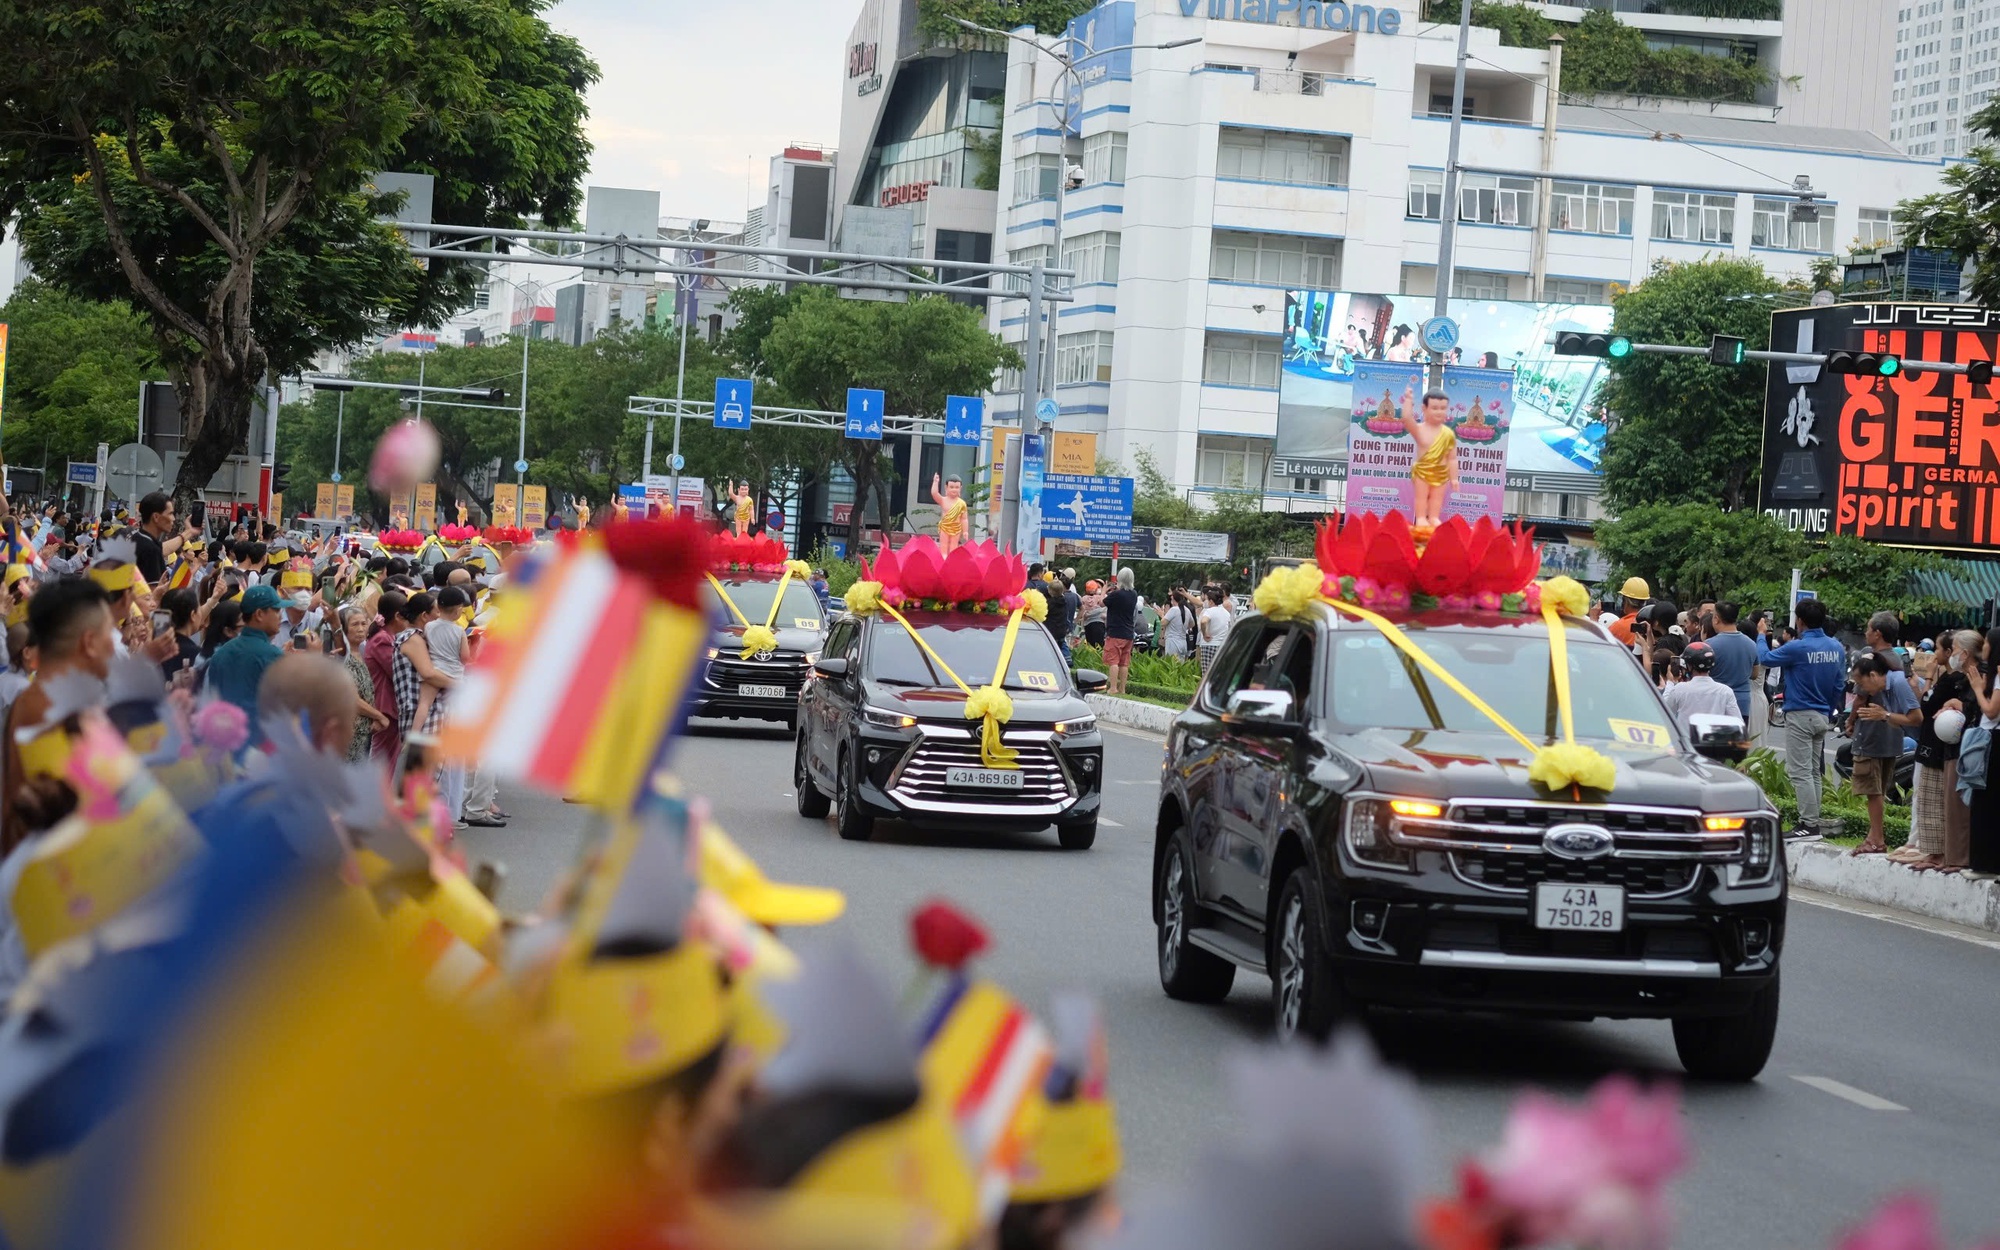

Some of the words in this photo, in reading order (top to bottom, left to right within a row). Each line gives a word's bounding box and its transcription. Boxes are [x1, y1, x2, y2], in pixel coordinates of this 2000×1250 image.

[1179, 0, 1401, 34] VinaPhone
[1949, 401, 1961, 455] JUNGER
[1354, 440, 1380, 451] CUNG
[1456, 447, 1469, 457] NG
[1369, 454, 1384, 466] LỢI
[1387, 455, 1412, 468] PHẬT
[1458, 460, 1472, 472] LỢI
[1476, 461, 1501, 474] PHẬT
[1289, 463, 1300, 473] LÊ
[1303, 464, 1345, 476] NGUYỄN
[1505, 478, 1529, 487] .655
[1841, 482, 1958, 537] spirit
[1807, 651, 1839, 663] VIETNAM
[1028, 675, 1049, 686] 08
[1628, 727, 1655, 745] 07
[1566, 834, 1598, 850] Ford
[1562, 888, 1598, 906] 43A
[1548, 909, 1613, 928] 750.28
